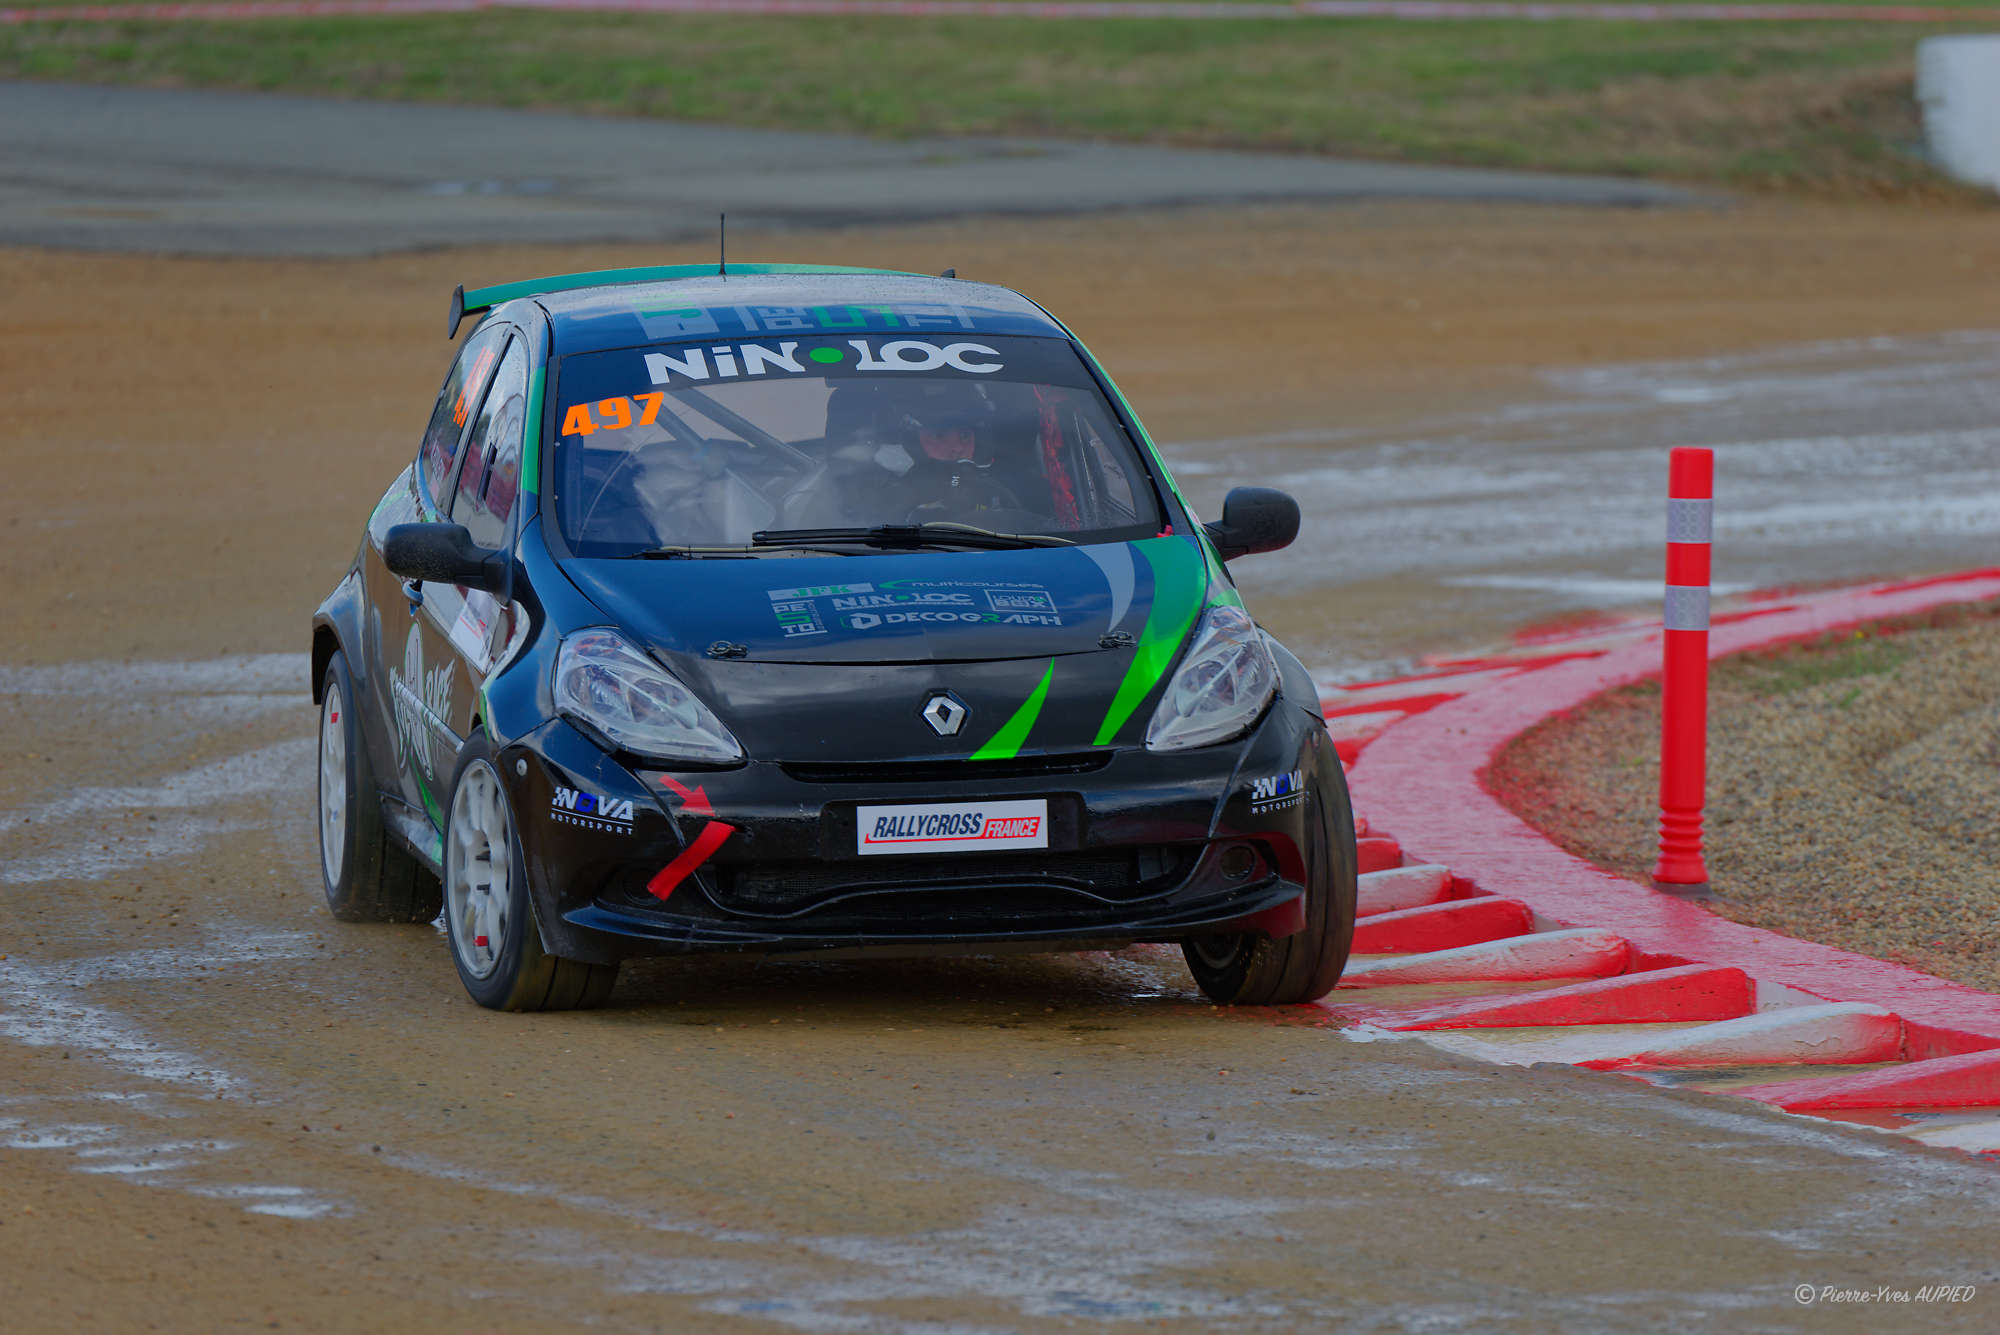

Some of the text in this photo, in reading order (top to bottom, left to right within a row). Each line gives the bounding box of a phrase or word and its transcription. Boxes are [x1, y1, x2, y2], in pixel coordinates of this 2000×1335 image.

[561, 391, 665, 437] 497
[1251, 768, 1305, 800] NOVA
[552, 786, 634, 821] NOVA
[550, 812, 633, 836] MOTORSPORT
[873, 812, 1038, 839] RALLYCROSS FRANCE
